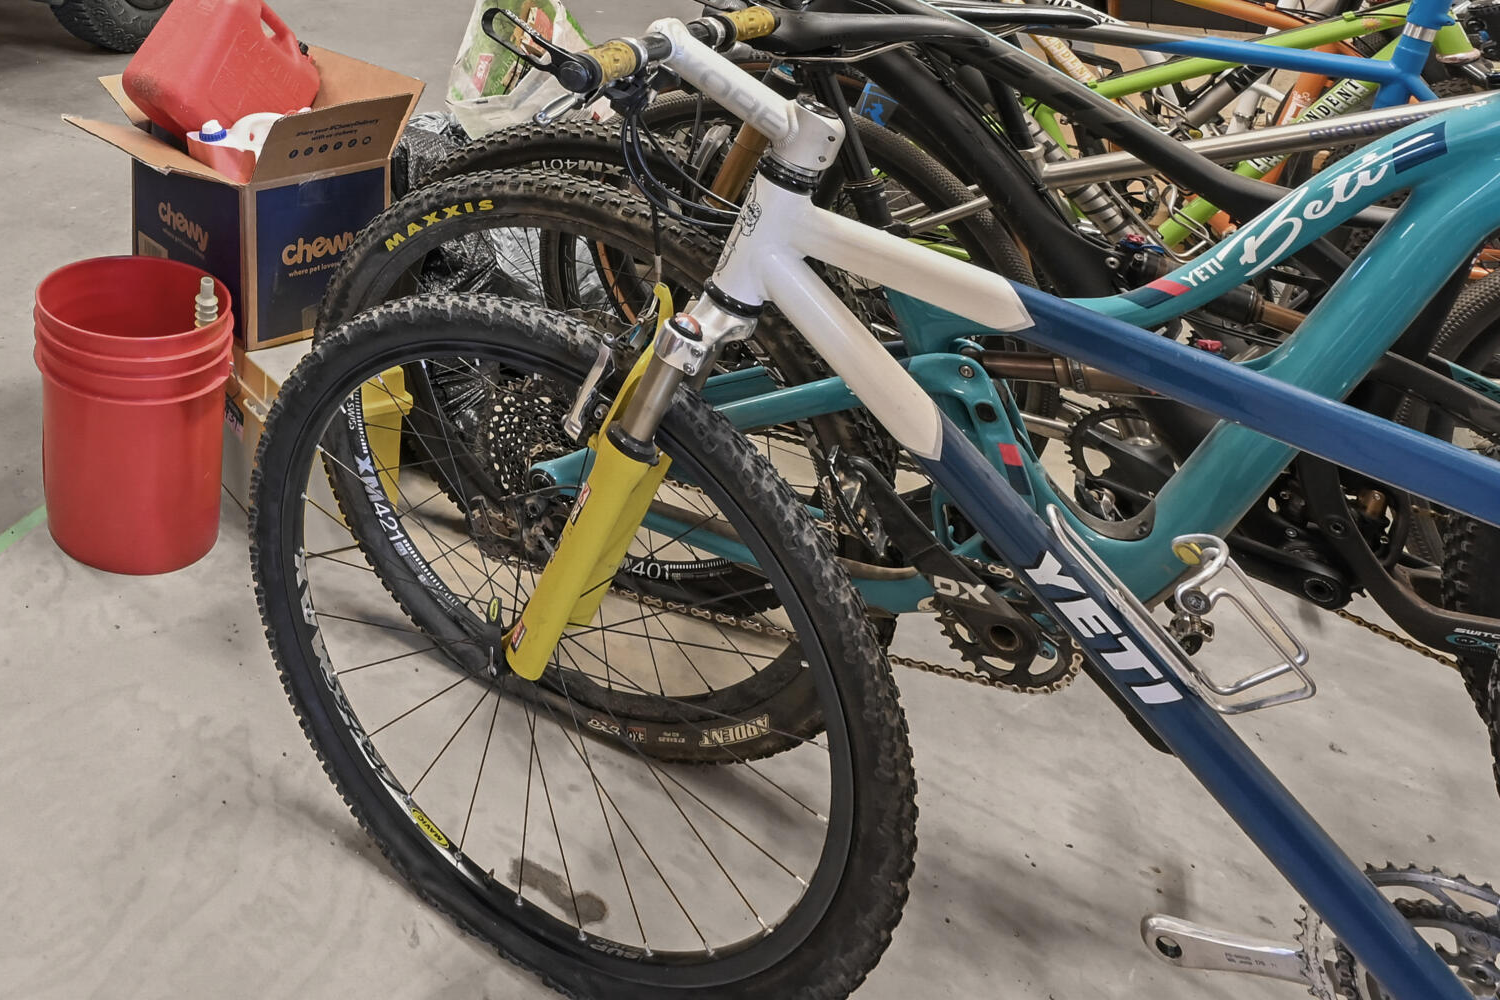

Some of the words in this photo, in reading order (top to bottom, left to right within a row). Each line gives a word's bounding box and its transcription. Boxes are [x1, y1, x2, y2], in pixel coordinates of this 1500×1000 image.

[158, 201, 210, 252] chewy
[384, 199, 495, 252] MAXXIS
[288, 266, 308, 278] where
[1180, 257, 1225, 288] YETI
[1024, 550, 1184, 705] YETI
[699, 713, 772, 747] ARDENT
[416, 813, 445, 845] MAVIC
